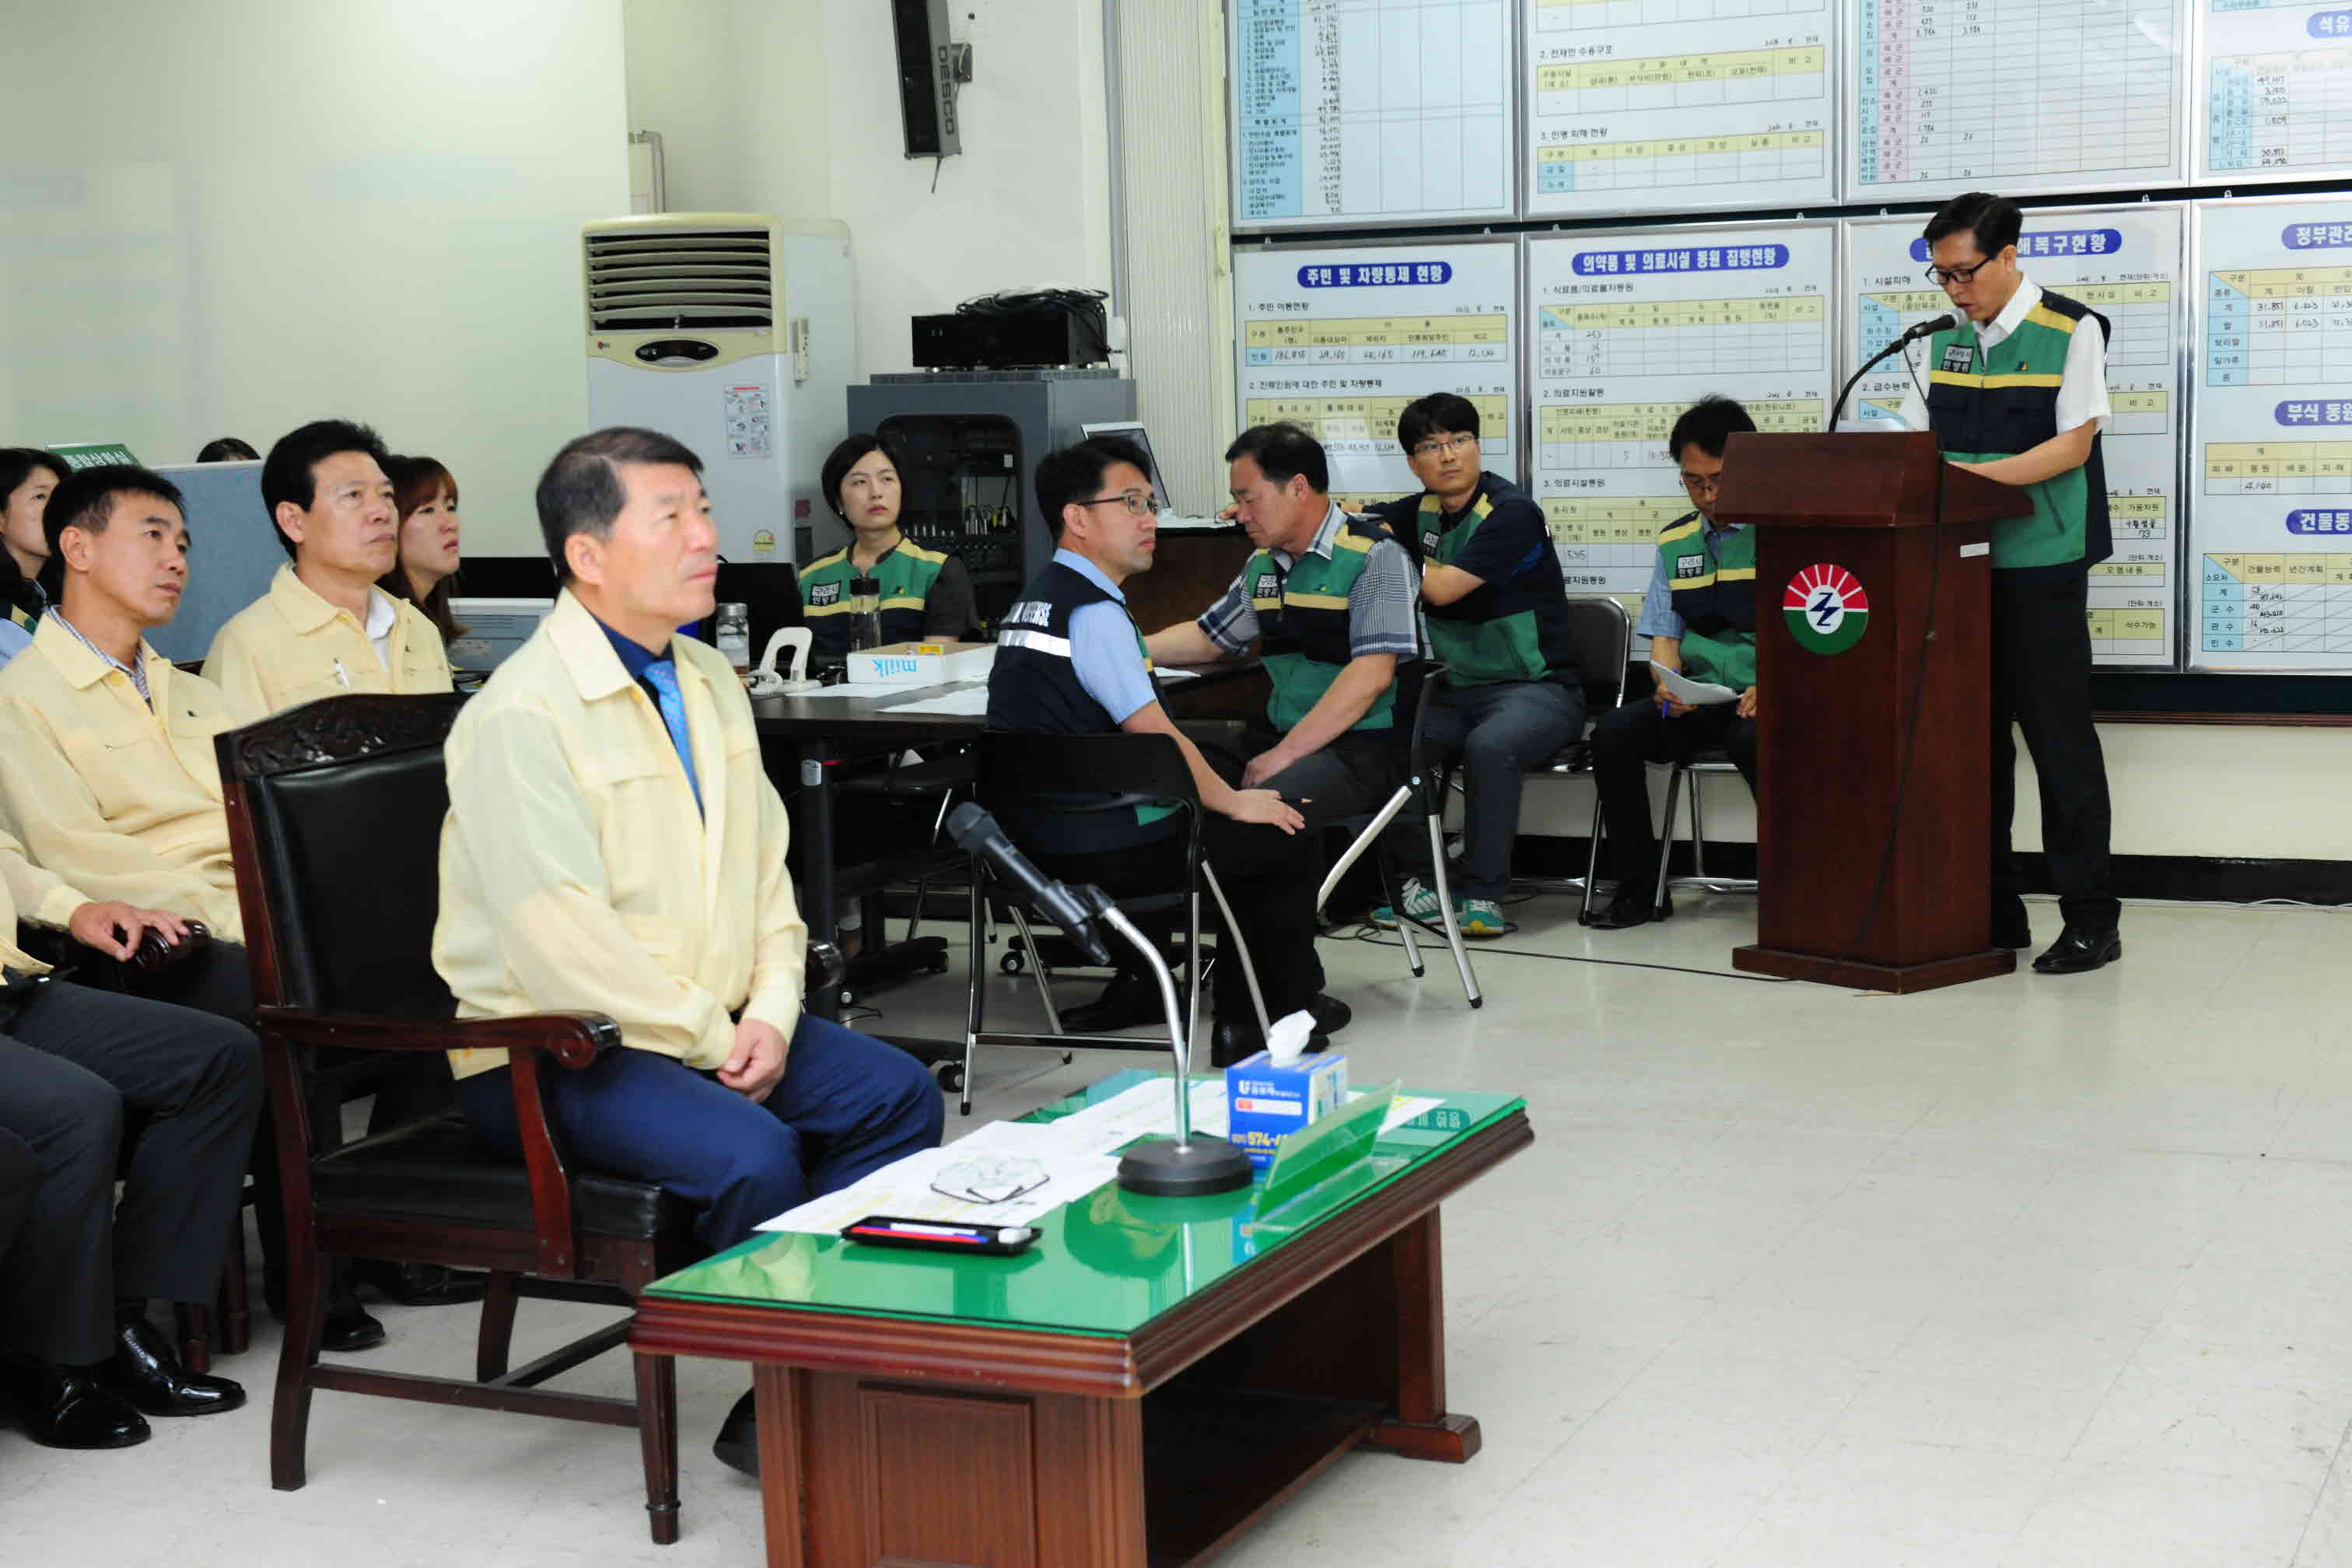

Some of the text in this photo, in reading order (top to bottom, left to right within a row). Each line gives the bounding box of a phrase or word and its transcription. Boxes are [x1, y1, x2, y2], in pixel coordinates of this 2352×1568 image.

[937, 45, 955, 135] DESCO
[1583, 247, 1776, 273] 의약품 및 의료시설 동원 집행현황
[1307, 264, 1444, 286] 주민 및 차량통제 현황
[1874, 275, 1911, 286] 시설피해
[2287, 404, 2319, 422] 부식
[1554, 478, 1605, 488] 의료시설동원
[872, 659, 917, 677] milk
